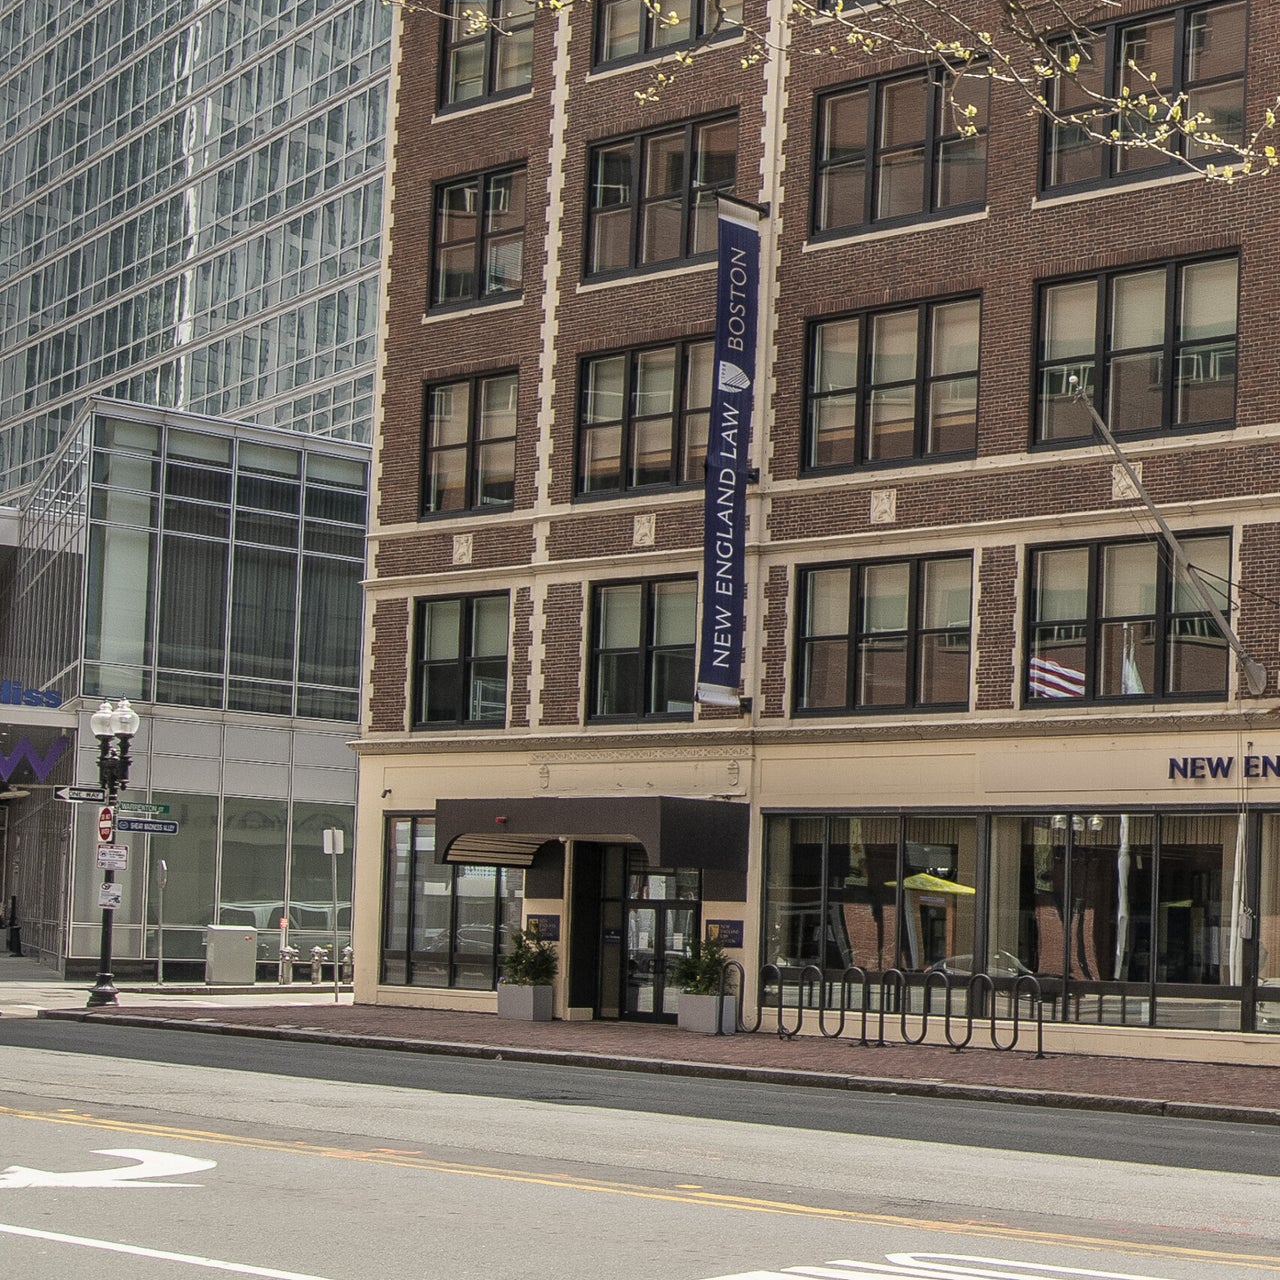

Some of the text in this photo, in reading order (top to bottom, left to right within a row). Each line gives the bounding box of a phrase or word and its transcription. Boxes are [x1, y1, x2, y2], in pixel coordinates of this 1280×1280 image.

[713, 247, 748, 668] NEW ENGLAND LAW BOSTON
[0, 735, 69, 783] W
[1168, 756, 1234, 780] NEW
